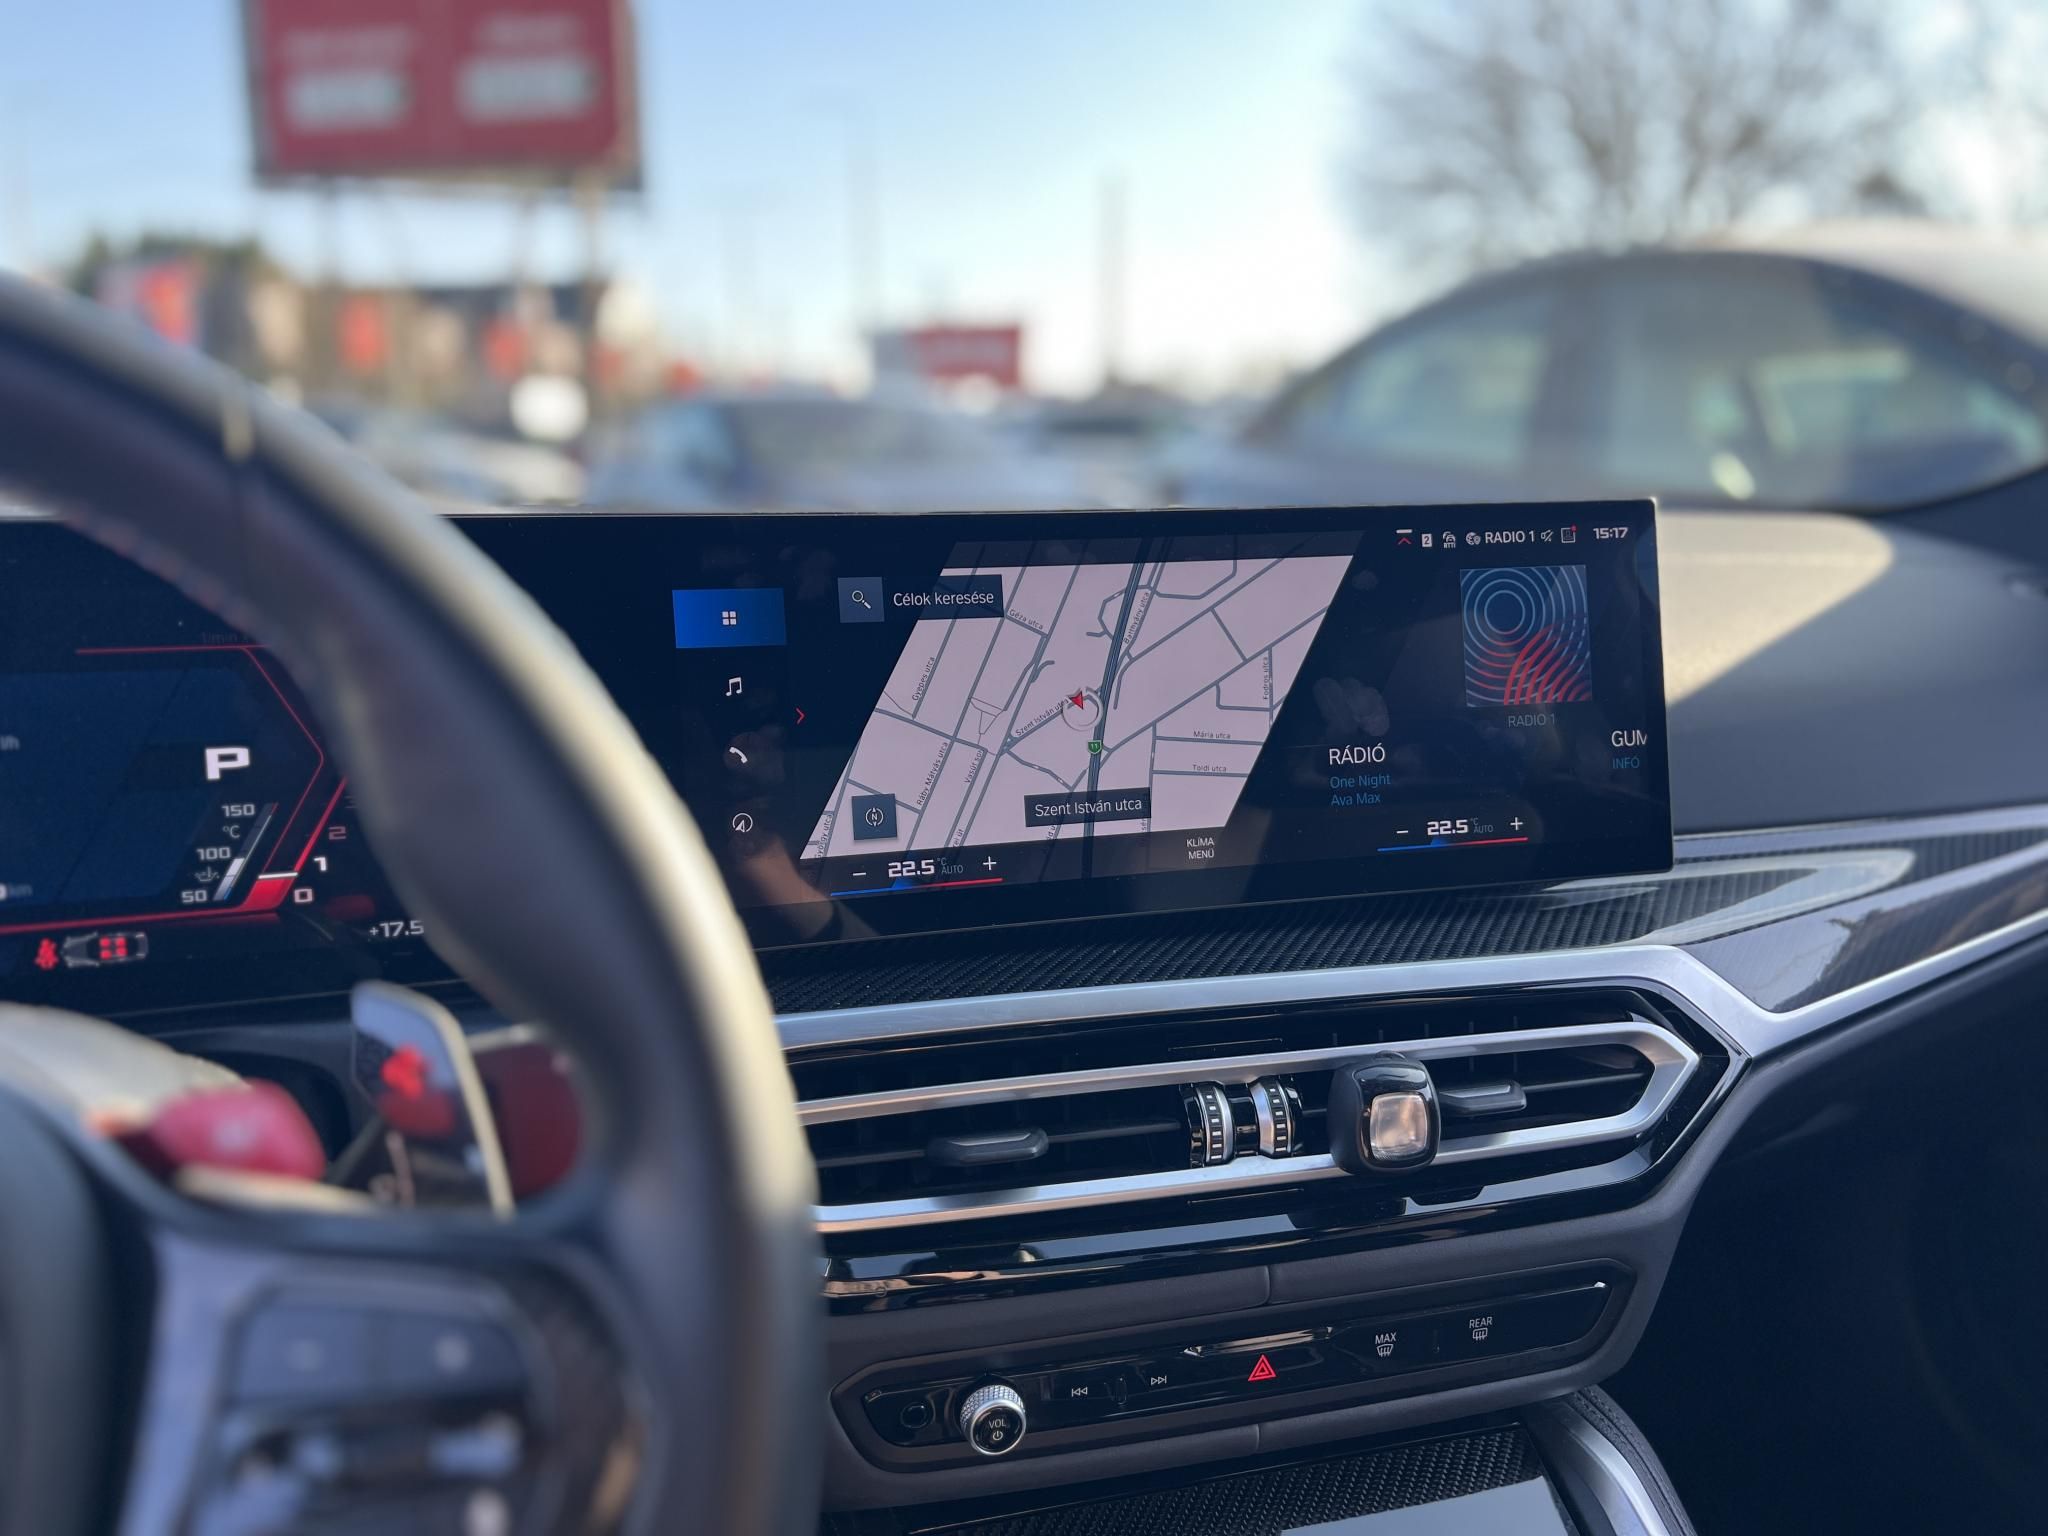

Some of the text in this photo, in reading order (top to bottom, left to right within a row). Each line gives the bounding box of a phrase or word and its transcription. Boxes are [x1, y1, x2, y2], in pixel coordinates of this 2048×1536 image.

[1485, 530, 1535, 544] RADIO 1
[1592, 527, 1629, 539] 15:17
[893, 592, 995, 606] Célok keresése
[1009, 609, 1044, 630] Géza utca
[911, 656, 936, 701] Gyepes utca
[1262, 674, 1270, 700] Fodros
[1015, 721, 1034, 736] Szent
[1033, 707, 1055, 724] István
[1508, 713, 1556, 727] RADIO 1
[1193, 730, 1232, 740] Mária utca
[1329, 743, 1386, 766] RÁDIÓ
[205, 747, 251, 781] P
[1193, 764, 1228, 773] Toldi utca
[1612, 756, 1640, 769] INFÓ
[916, 741, 949, 806] Ráby Mátyás utca
[963, 761, 976, 784] Vasút
[1330, 773, 1392, 789] One Night
[1331, 793, 1381, 806] Ava Max
[221, 803, 256, 817] 150
[1035, 799, 1142, 817] Szent István utca
[222, 825, 240, 839] °C
[328, 826, 347, 840] 2
[1427, 819, 1469, 836] 22.5
[1474, 824, 1494, 834] AUTO
[1186, 837, 1215, 848] KLÍMA
[196, 847, 231, 861] 100
[1188, 849, 1215, 860] MENÜ
[313, 857, 328, 871] 1
[888, 859, 935, 878] 22.5
[941, 864, 964, 875] AUTO
[181, 890, 207, 903] 50
[293, 888, 314, 903] 0
[1469, 1316, 1493, 1329] REAR
[1374, 1332, 1397, 1345] MAX
[988, 1418, 1007, 1429] VOL
